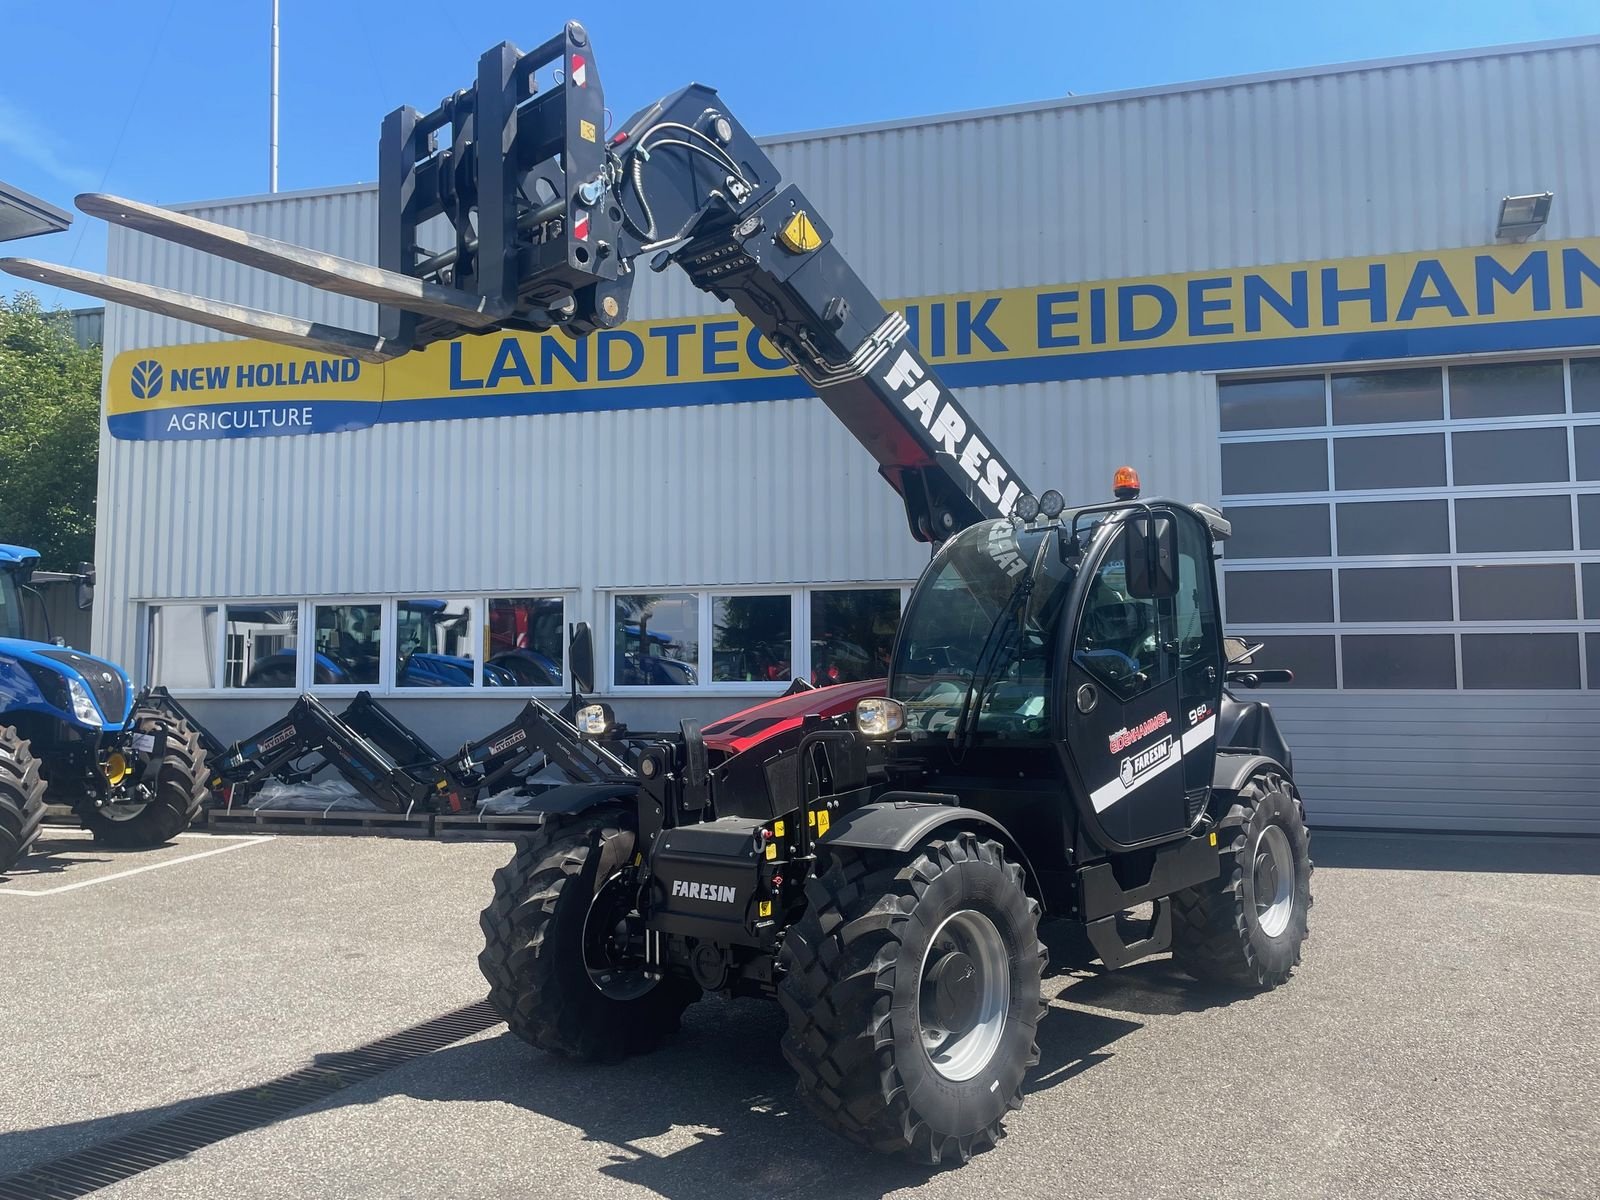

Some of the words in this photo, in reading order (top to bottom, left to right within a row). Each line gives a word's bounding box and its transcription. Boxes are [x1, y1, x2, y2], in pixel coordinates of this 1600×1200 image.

[450, 298, 1009, 390] LANDTECIK
[170, 366, 230, 392] NEW
[236, 358, 361, 388] HOLLAND
[167, 407, 313, 432] AGRICULTURE
[883, 349, 1024, 517] FARESI
[1188, 704, 1207, 725] 960
[264, 728, 296, 750] HYDRAC
[496, 733, 526, 752] HYDRAC
[1134, 741, 1167, 774] FARESIN
[672, 880, 737, 904] FARESIN
